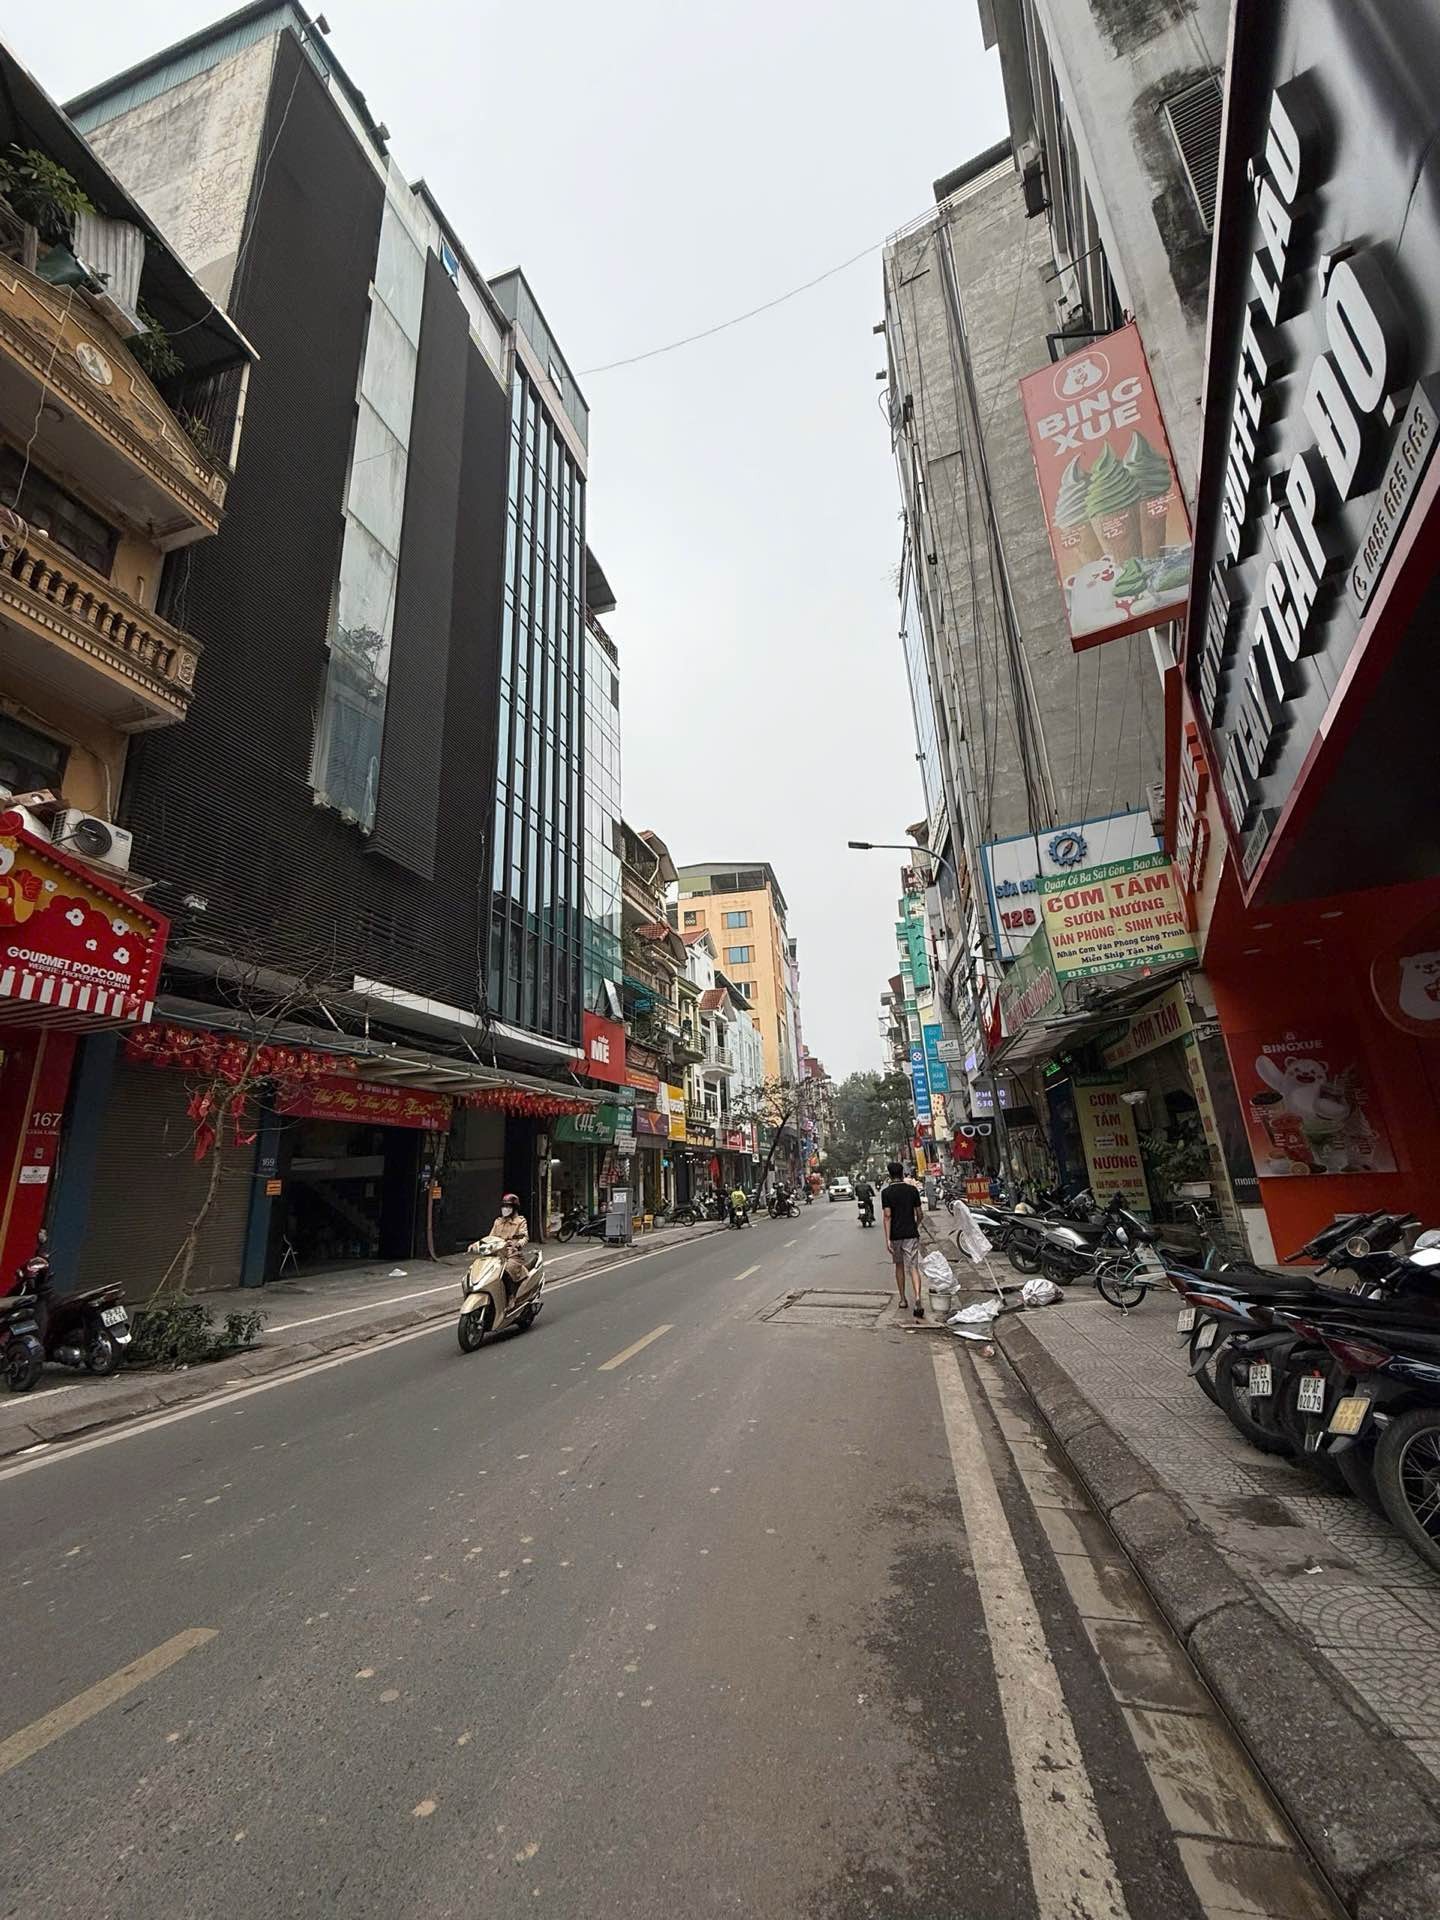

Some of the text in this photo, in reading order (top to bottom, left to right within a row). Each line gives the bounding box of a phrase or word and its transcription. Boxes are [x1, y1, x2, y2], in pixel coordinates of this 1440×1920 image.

[1223, 304, 1268, 562] BUFFET
[1247, 89, 1300, 327] LẨU
[1303, 255, 1396, 502] ĐỘ
[1037, 377, 1142, 440] BING
[1053, 400, 1141, 456] XUE
[1265, 453, 1327, 662] CẤP
[1255, 607, 1285, 702] 7
[1237, 651, 1273, 780] CAY
[1080, 873, 1091, 883] Ba
[1108, 864, 1126, 875] Gòn
[1133, 858, 1150, 870] Bao
[1046, 872, 1171, 913] CƠM TẤM
[1063, 897, 1165, 927] SƯỜN NƯỚNG
[1001, 907, 1037, 929] 126
[1052, 931, 1074, 947] VĂN
[1077, 924, 1115, 942] PHÒNG
[1125, 917, 1153, 934] SINH
[1157, 909, 1184, 927] VIÊN
[7, 946, 132, 985] GOURMET POPCORN
[1090, 960, 1124, 975] 0834
[1129, 956, 1154, 969] 742
[1157, 950, 1185, 963] 345
[1104, 949, 1125, 962] Ship
[1262, 1039, 1324, 1054] BINGXUE
[32, 1112, 63, 1127] 167
